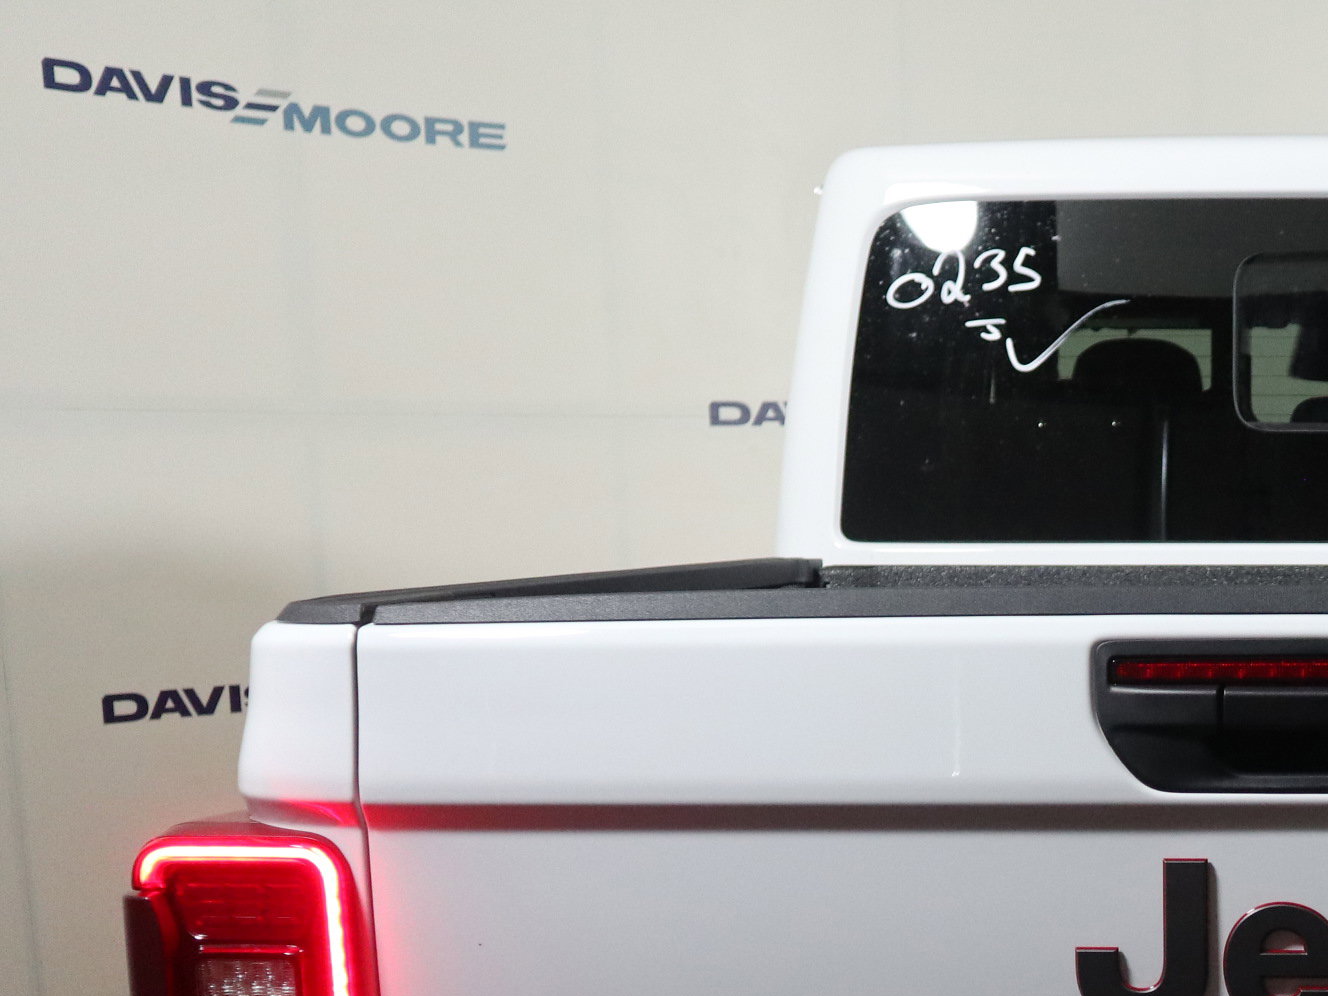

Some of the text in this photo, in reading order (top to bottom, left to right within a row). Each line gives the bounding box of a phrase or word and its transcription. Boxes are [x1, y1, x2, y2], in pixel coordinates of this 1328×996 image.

[41, 56, 507, 151] DAVIS MOORE
[886, 247, 1042, 309] 0235
[708, 401, 787, 426] DA
[101, 684, 249, 724] DAVI
